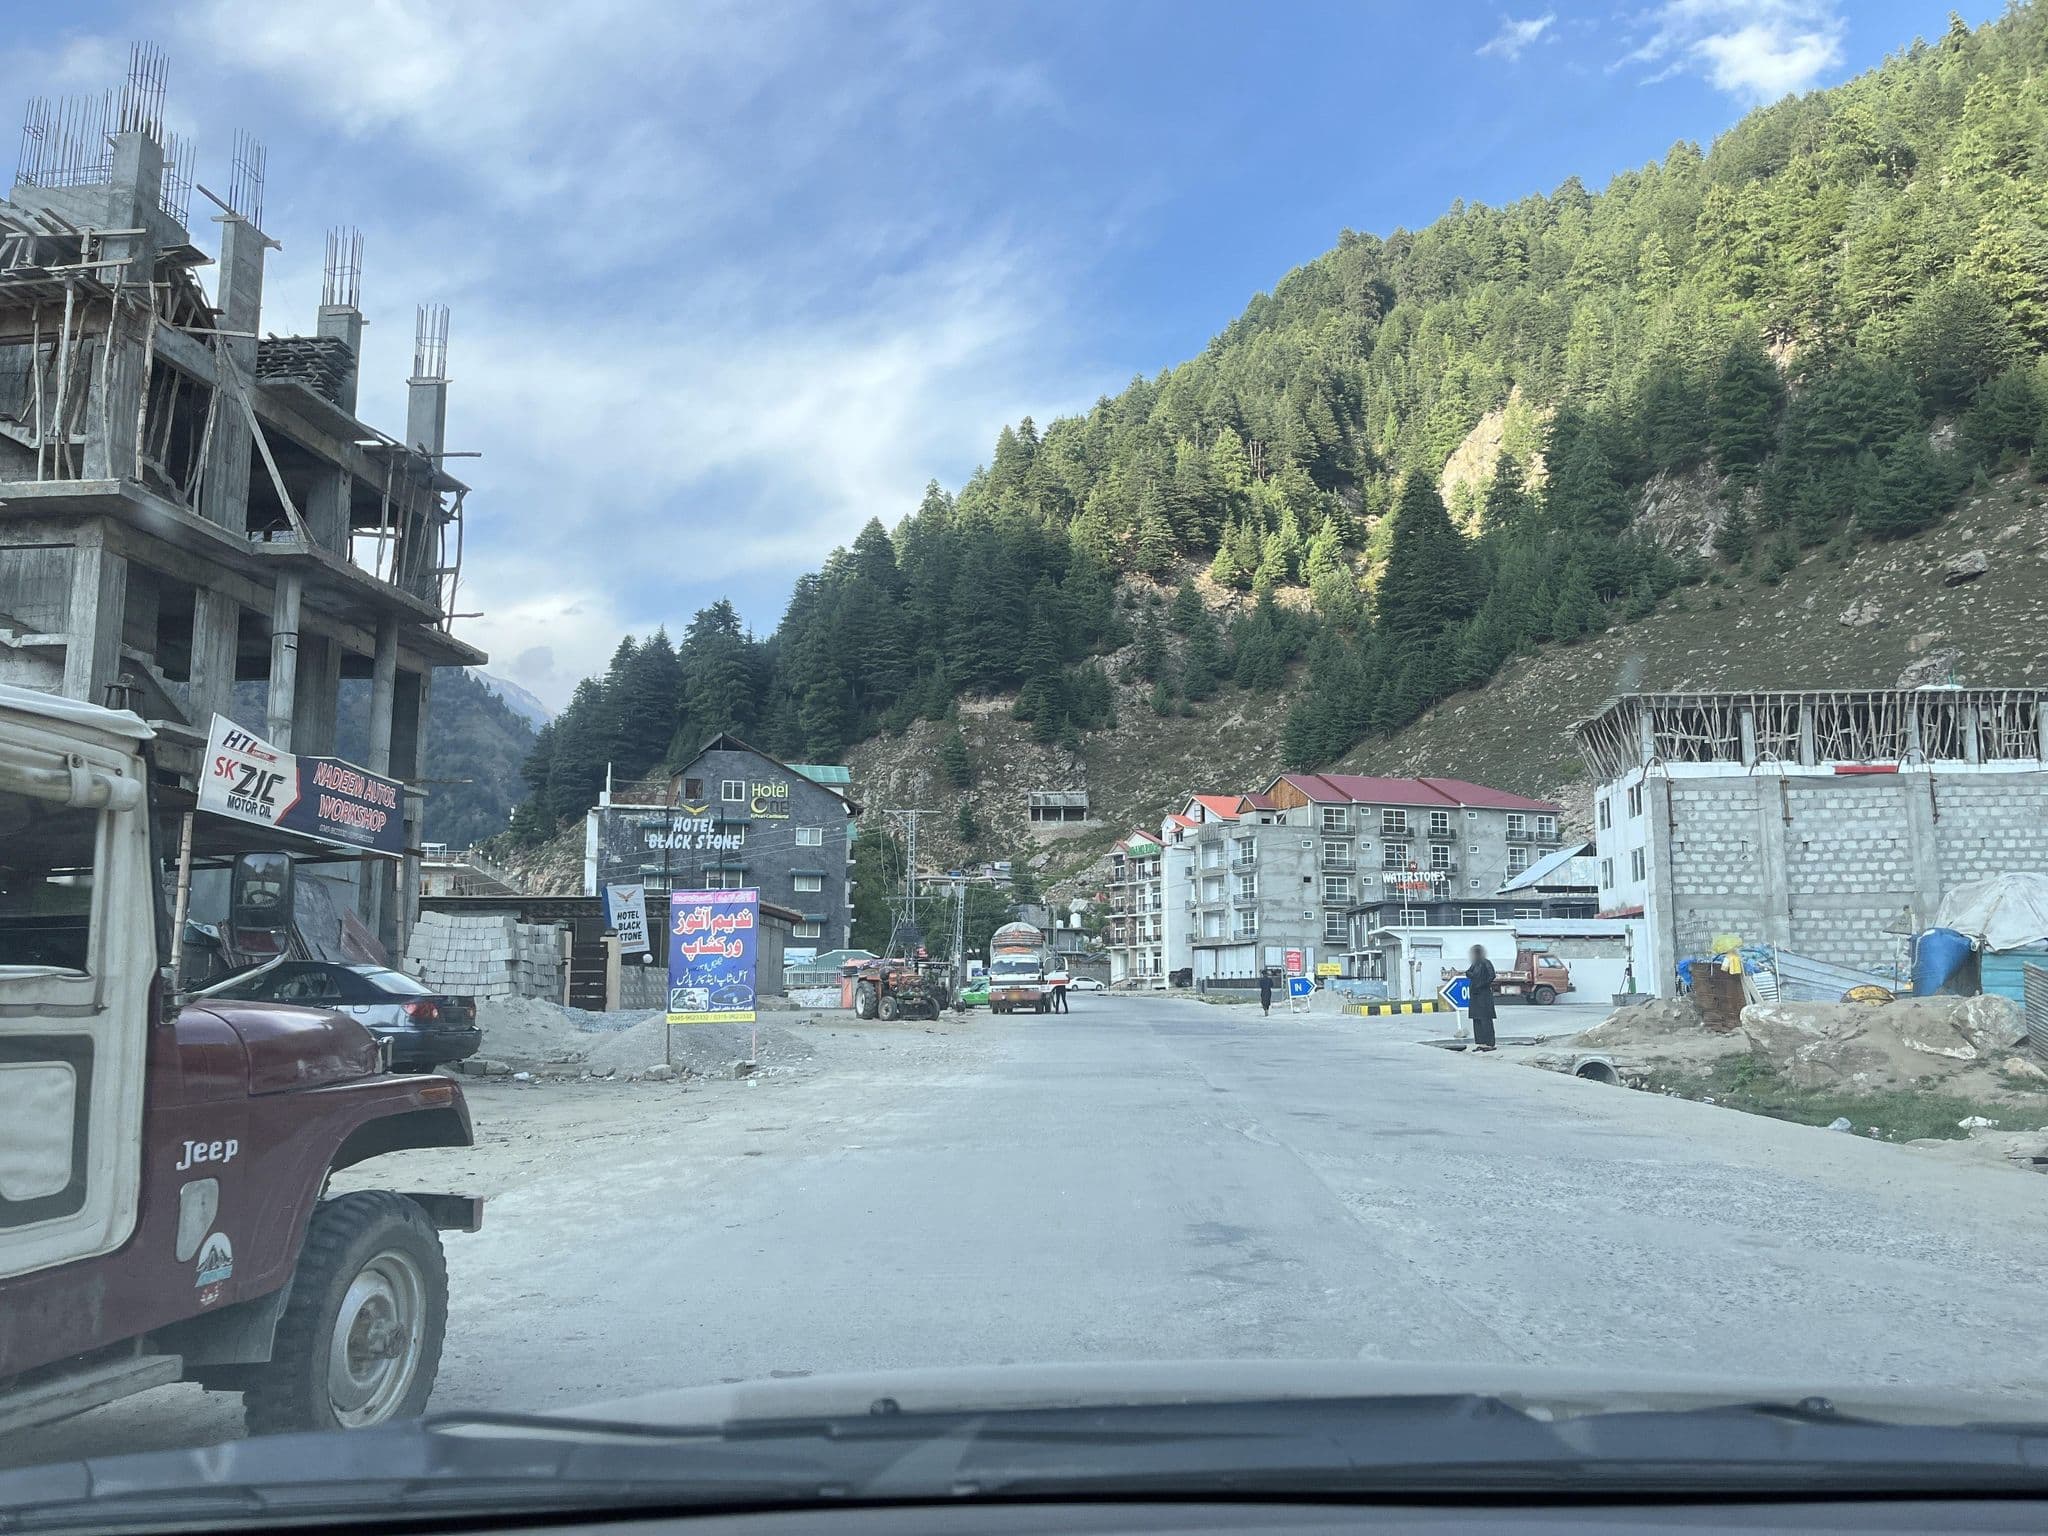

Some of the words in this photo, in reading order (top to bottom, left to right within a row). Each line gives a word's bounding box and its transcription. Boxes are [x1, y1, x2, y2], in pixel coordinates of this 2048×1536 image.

[214, 756, 238, 780] SK
[229, 763, 286, 806] ZIC
[313, 761, 365, 799] NADEEM
[751, 782, 789, 798] Hotel
[227, 795, 258, 815] MOTOR
[259, 804, 272, 818] OIL
[318, 794, 387, 832] WORKSHOP
[673, 817, 715, 833] HOTEL
[648, 834, 691, 850] BLACK
[695, 833, 741, 850] STONE
[617, 910, 640, 920] HOTEL
[618, 921, 641, 931] BLACK
[710, 908, 753, 936] ندیم
[620, 931, 642, 941] STONE
[681, 935, 743, 962] ورکشاپ
[175, 1139, 239, 1171] Jeep
